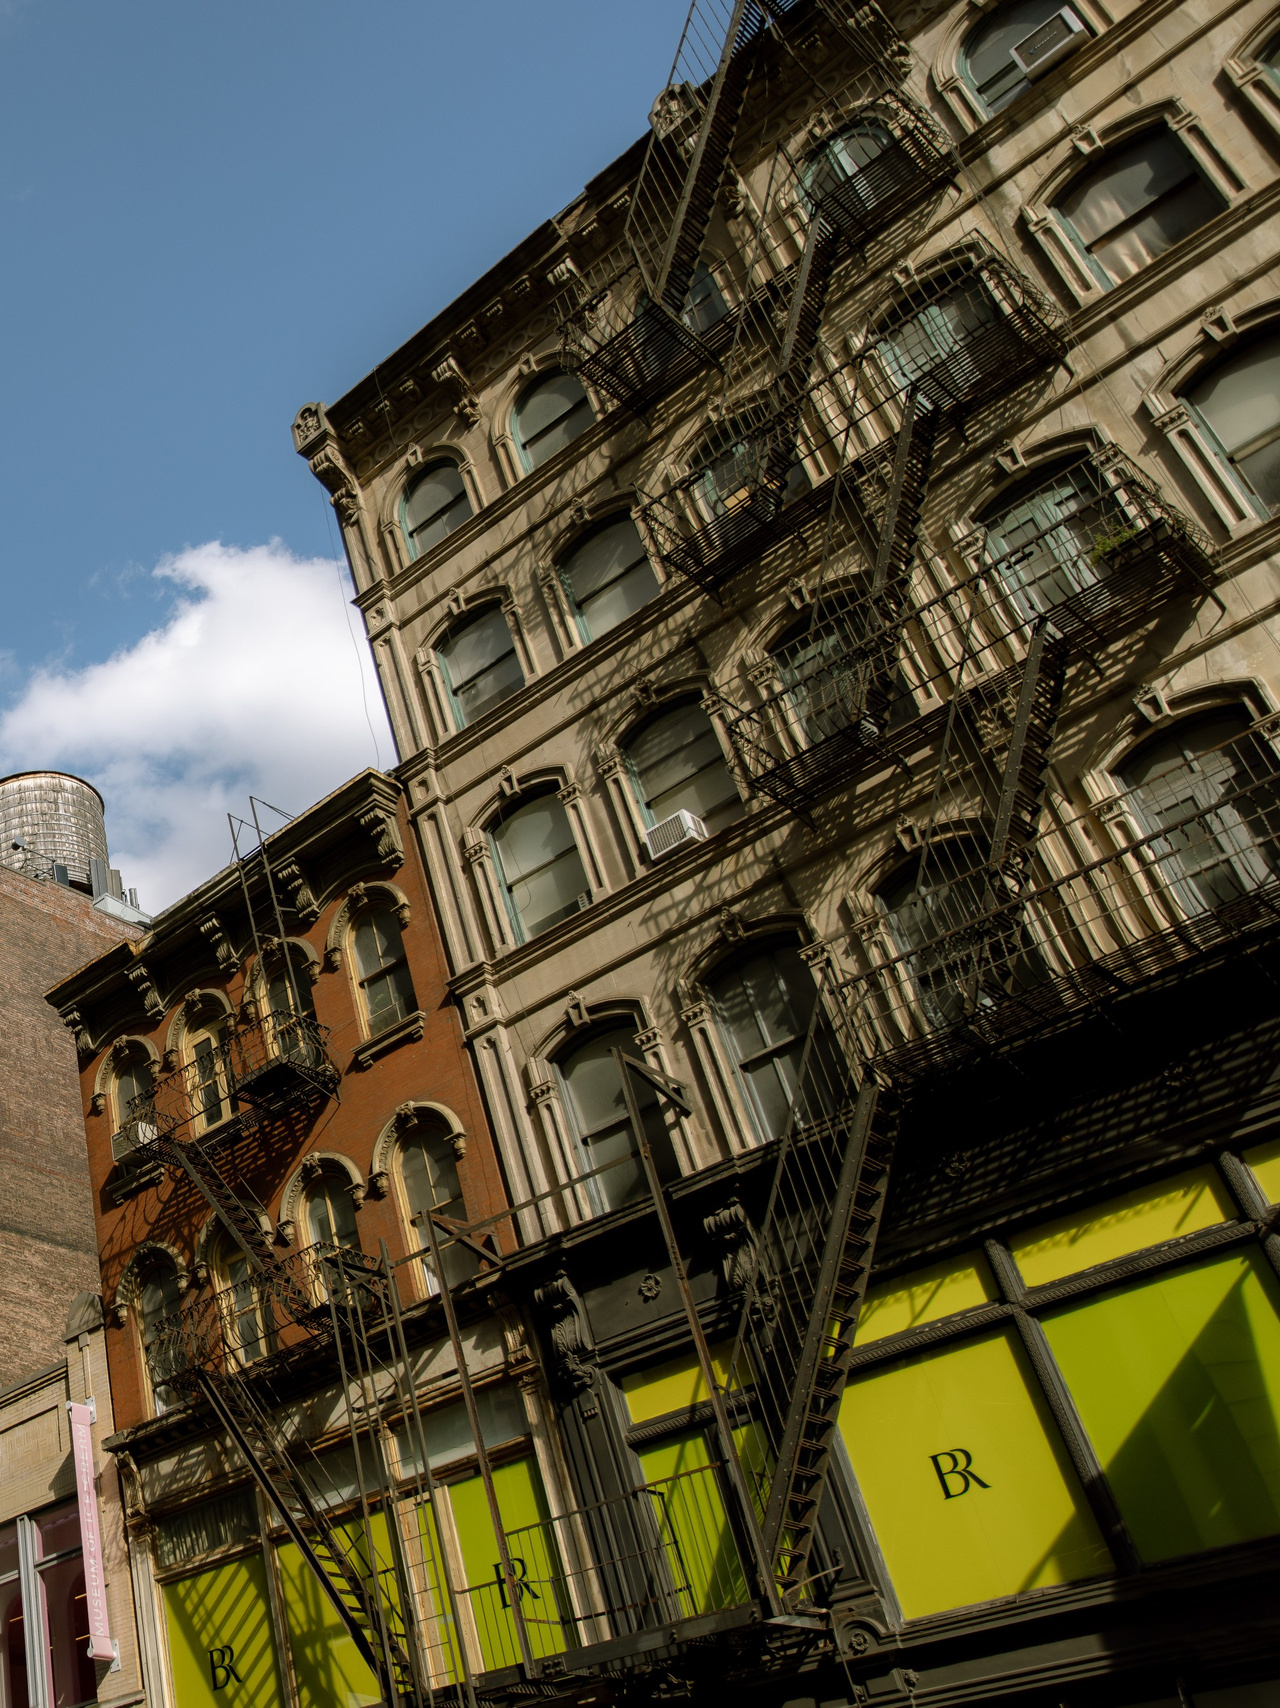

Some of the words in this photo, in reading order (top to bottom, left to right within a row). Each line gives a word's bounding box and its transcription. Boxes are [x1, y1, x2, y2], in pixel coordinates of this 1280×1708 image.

[76, 1423, 90, 1486] CREAM
[928, 1448, 992, 1500] BR
[86, 1531, 96, 1551] OF
[89, 1559, 105, 1636] MUSEUM
[207, 1645, 243, 1691] BR
